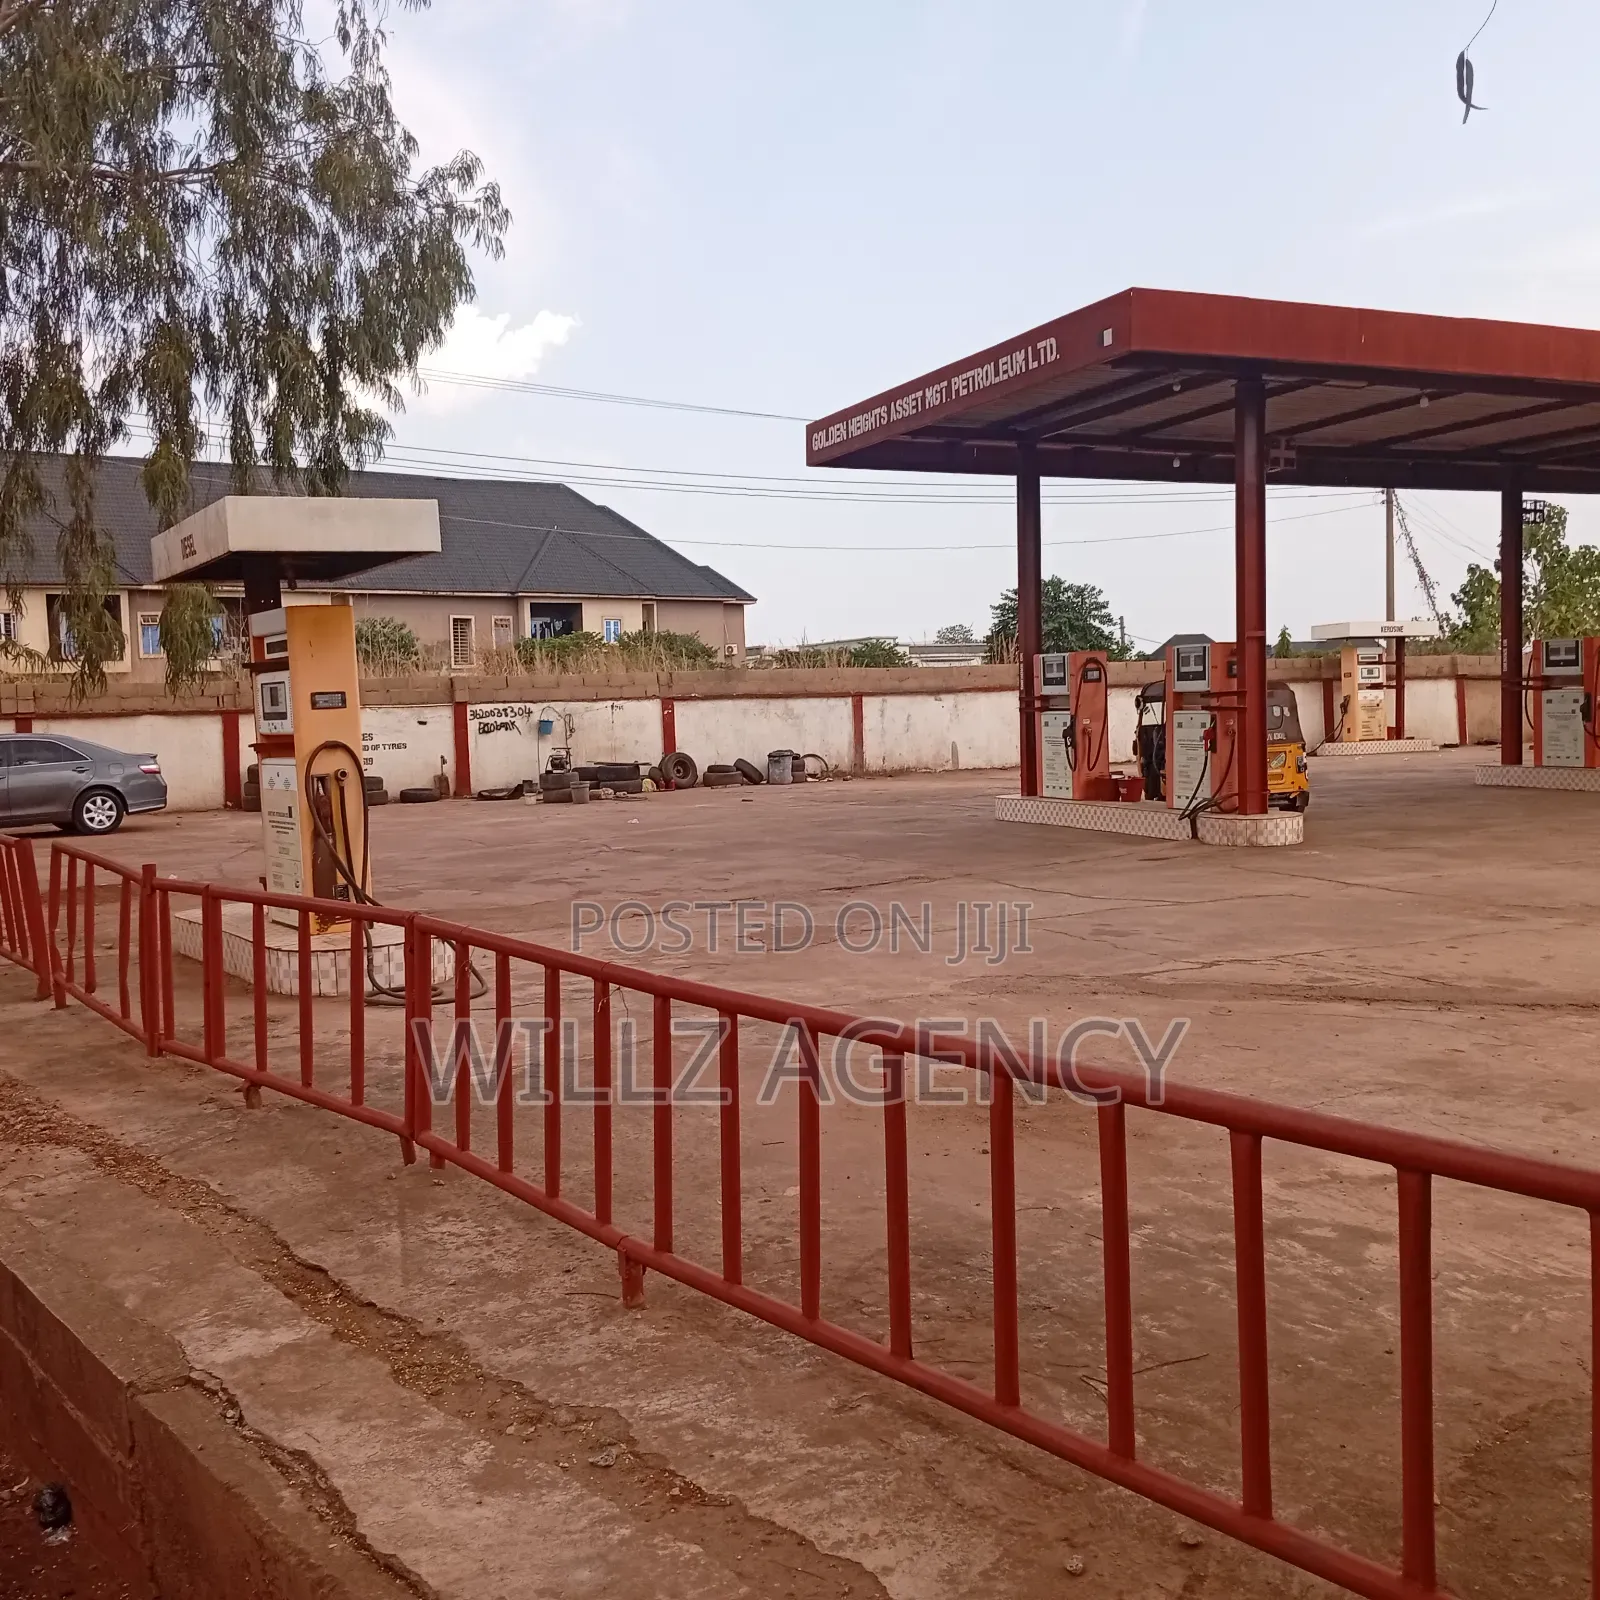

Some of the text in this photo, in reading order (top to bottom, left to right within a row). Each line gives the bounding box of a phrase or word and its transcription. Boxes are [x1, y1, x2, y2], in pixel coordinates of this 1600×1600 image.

[812, 424, 847, 451] GOLDEN
[848, 405, 888, 438] HEIGHTS
[890, 390, 922, 422] ASSET
[951, 351, 1025, 398] PETROLEUM
[1028, 336, 1060, 370] LTD.
[382, 742, 407, 750] TYRES
